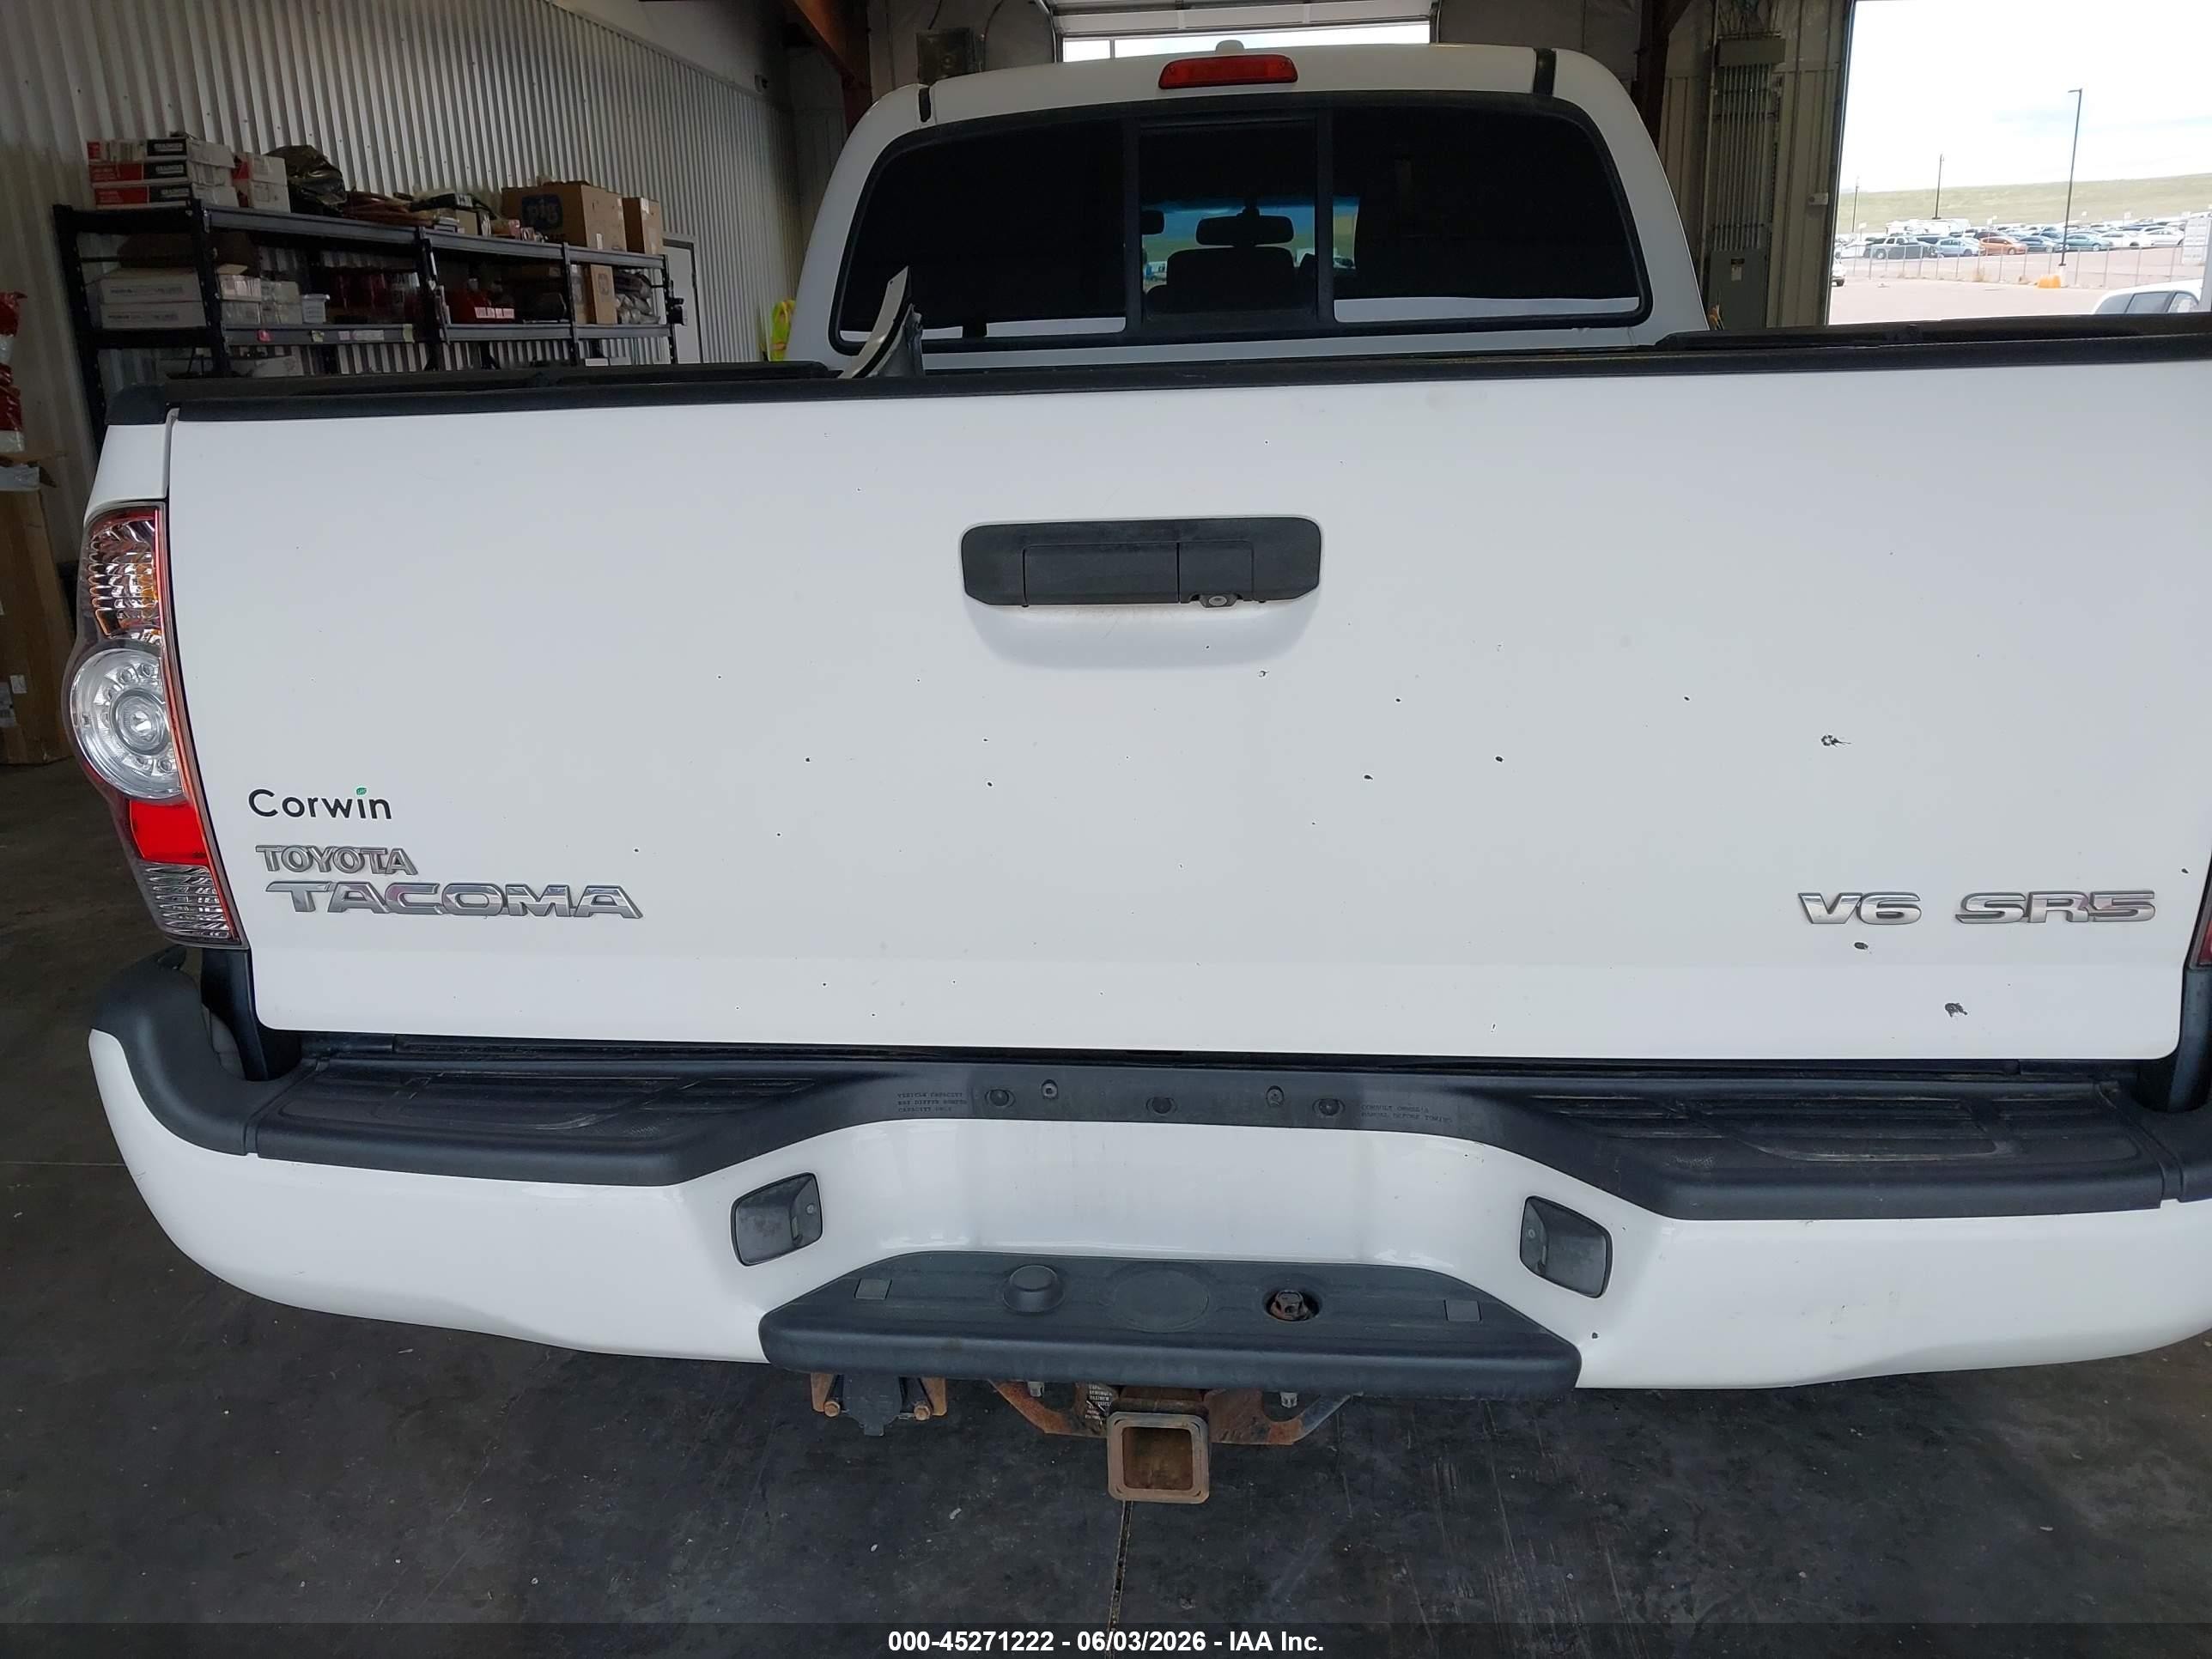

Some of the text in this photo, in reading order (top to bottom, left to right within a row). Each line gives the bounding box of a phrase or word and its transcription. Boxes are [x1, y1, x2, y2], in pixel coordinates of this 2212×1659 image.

[248, 787, 392, 819] Corwin
[255, 844, 418, 876] TOYOTA
[266, 881, 643, 919] TACOMA
[1797, 890, 2156, 925] V6 SR5
